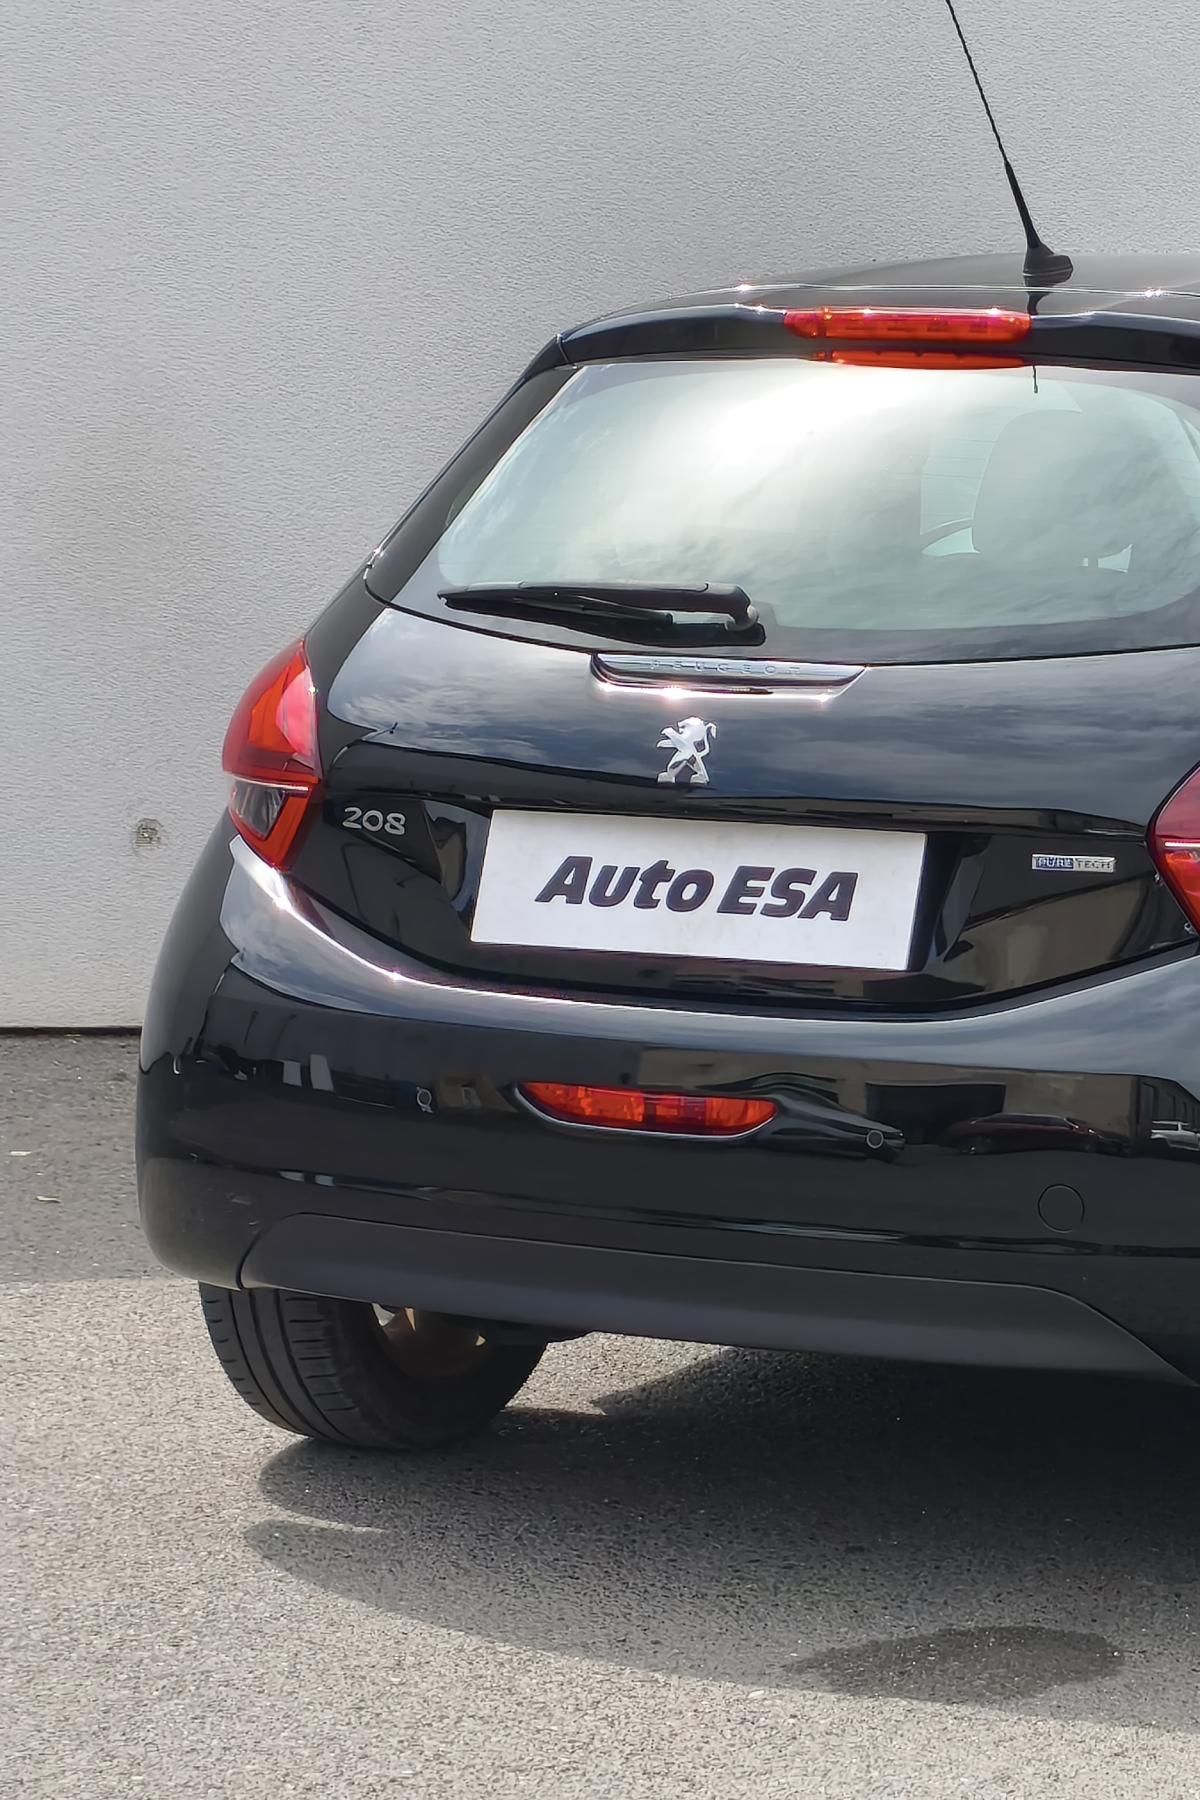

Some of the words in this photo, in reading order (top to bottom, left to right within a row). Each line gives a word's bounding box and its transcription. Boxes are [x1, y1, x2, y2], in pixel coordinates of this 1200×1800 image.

[649, 659, 801, 676] PEUGEOT
[342, 806, 406, 836] 208
[534, 855, 715, 913] Auto
[716, 865, 859, 922] ESA
